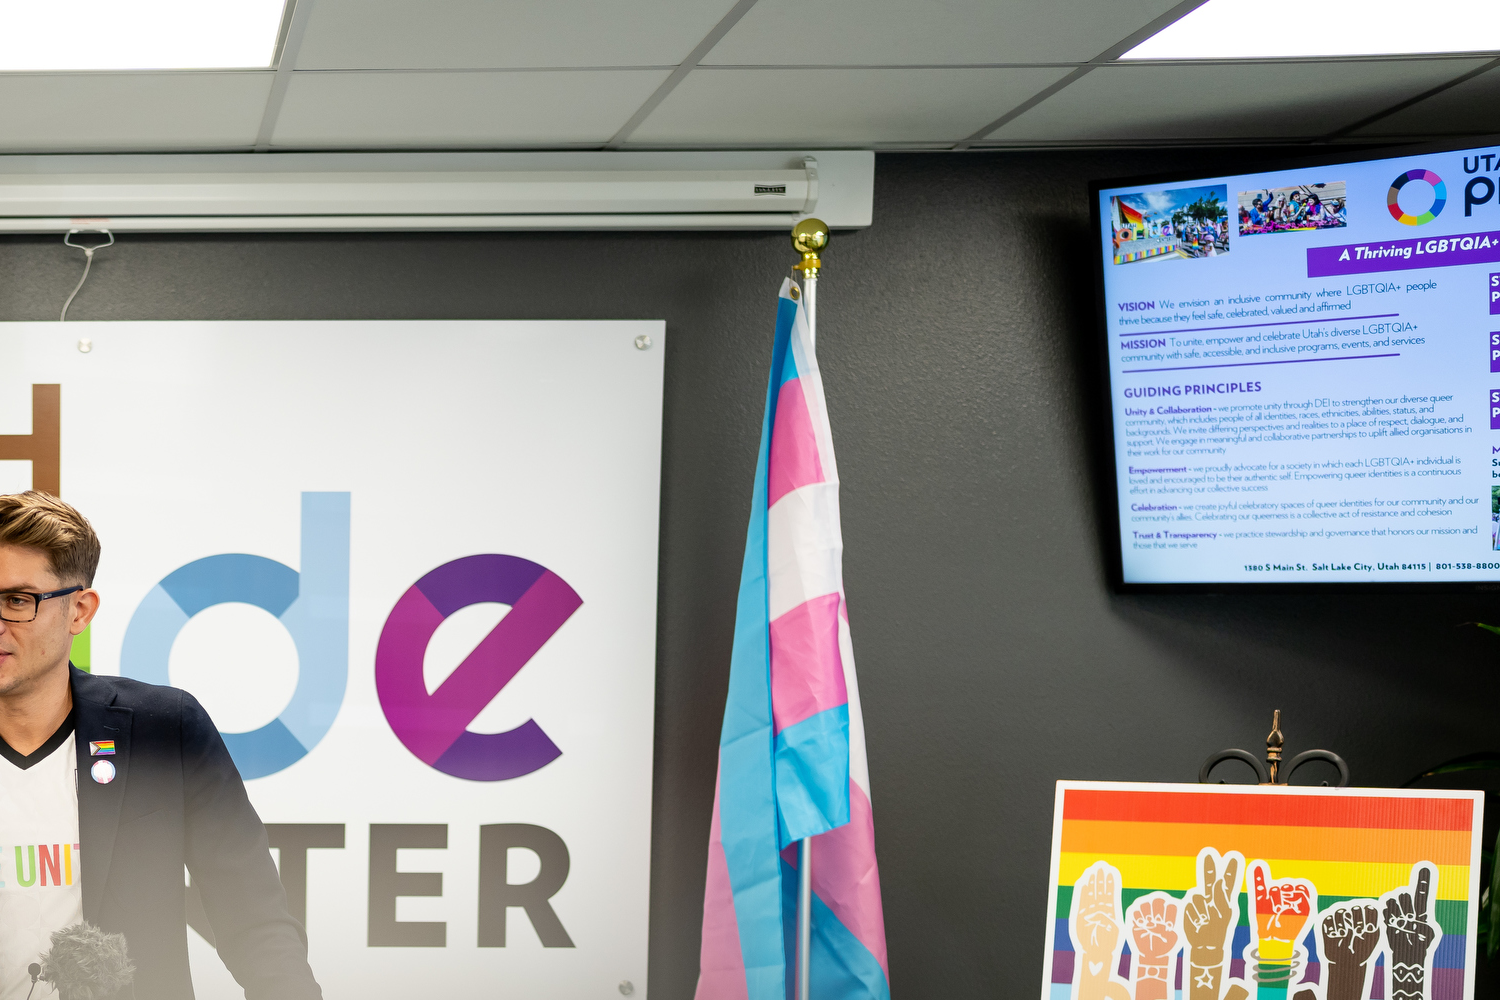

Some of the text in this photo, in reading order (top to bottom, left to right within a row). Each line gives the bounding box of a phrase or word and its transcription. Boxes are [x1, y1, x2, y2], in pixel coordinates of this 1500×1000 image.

[1463, 153, 1500, 174] UT
[1338, 235, 1499, 261] A Thriving LGBTQIA+
[1117, 300, 1155, 311] VISION
[1158, 300, 1174, 308] We
[1178, 300, 1210, 308] envision
[1227, 294, 1260, 304] inclusive
[1264, 292, 1311, 301] community
[1315, 288, 1342, 297] where
[1346, 282, 1400, 295] LGBTQIA+
[1406, 279, 1437, 292] people
[1118, 300, 1351, 325] thrive because they feel safe, celebrated, valued and affirmed
[1120, 322, 1417, 349] MISSION To unite, empower and celebrate Utah's diverse LGBTQIA+
[1120, 336, 1425, 362] community with safe, accessible, and inclusive programs, events, and services
[1123, 381, 1261, 398] GUIDING PRINCIPLES
[1353, 562, 1374, 571] City,
[1377, 562, 1399, 570] Utah
[15, 843, 80, 888] UNI
[185, 823, 577, 948] TER
